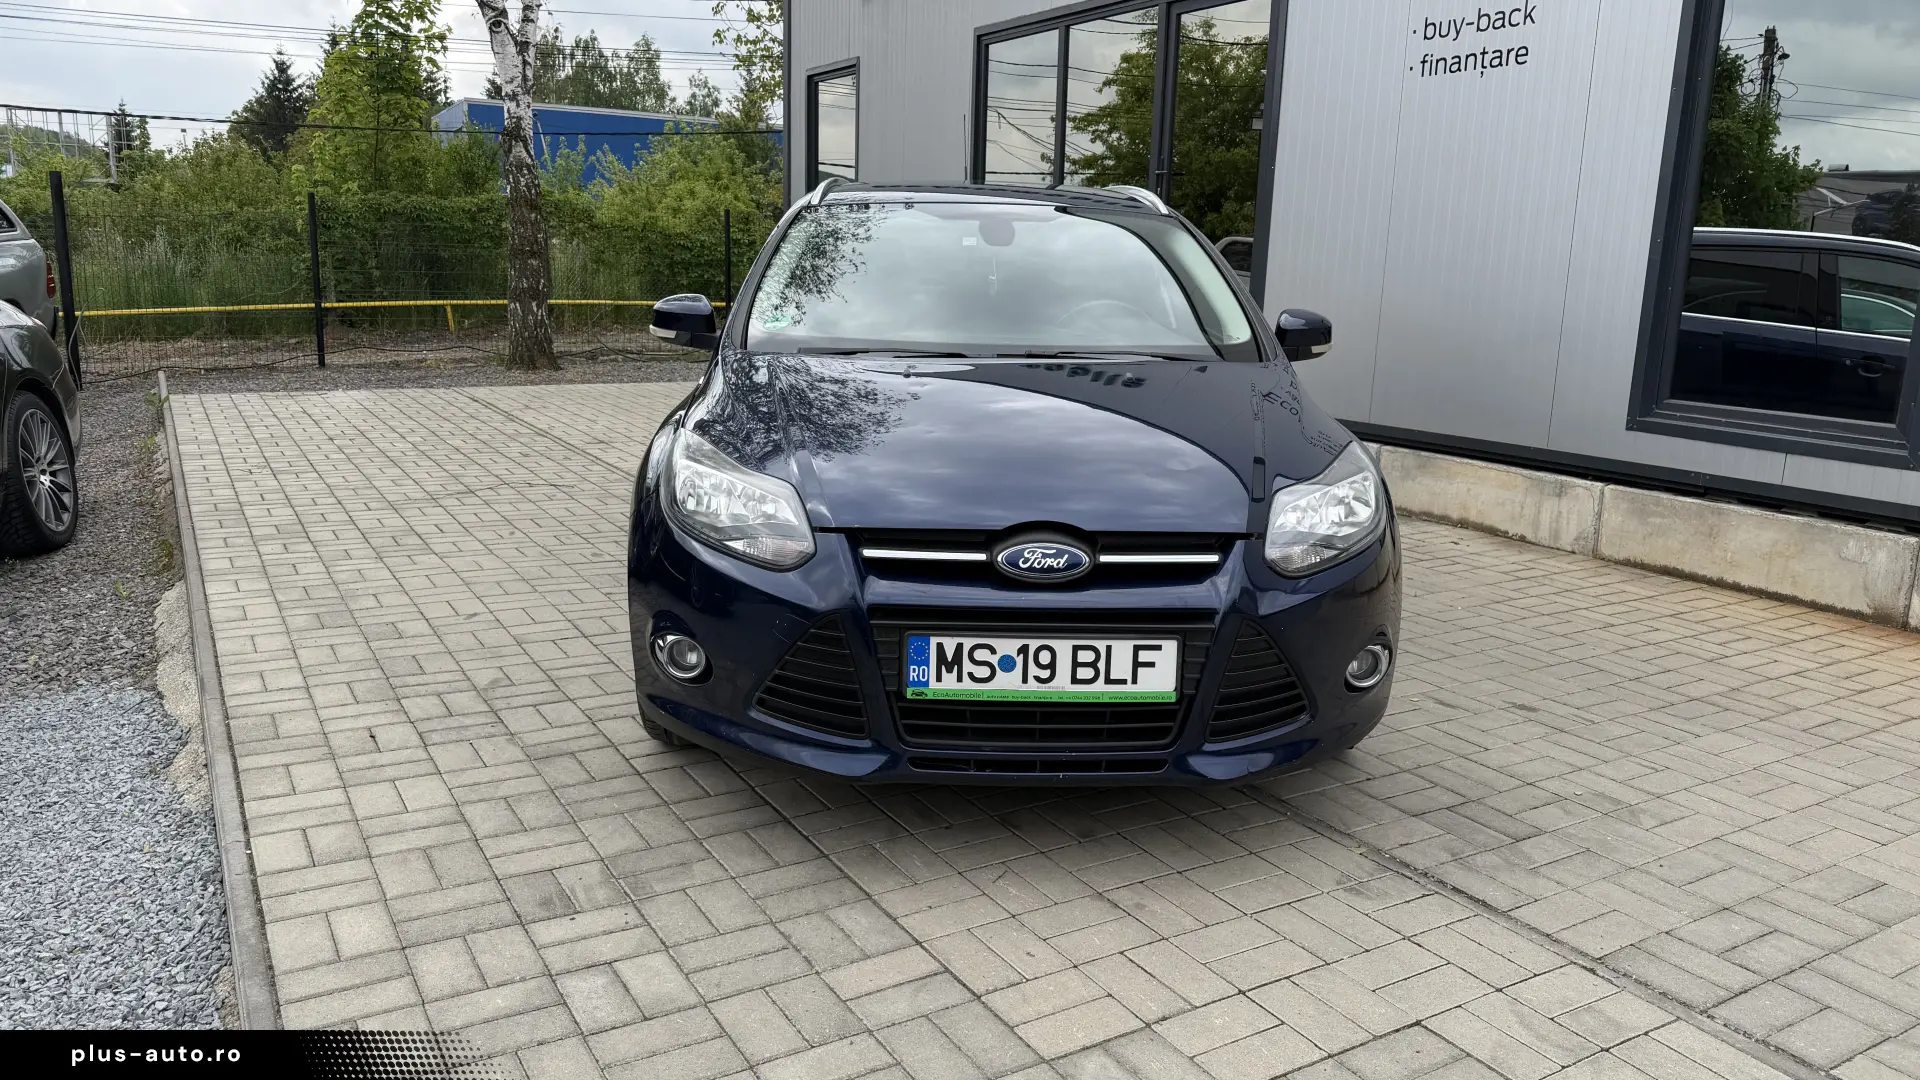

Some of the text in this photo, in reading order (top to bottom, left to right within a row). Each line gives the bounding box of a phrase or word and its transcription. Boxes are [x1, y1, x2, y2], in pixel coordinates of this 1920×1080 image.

[1423, 0, 1537, 41] buy-back
[1420, 45, 1529, 78] finanțare
[1018, 548, 1069, 570] Ford
[909, 665, 928, 682] RO
[935, 642, 1163, 685] MS 19 BLF
[932, 691, 982, 699] EcoAutomobile
